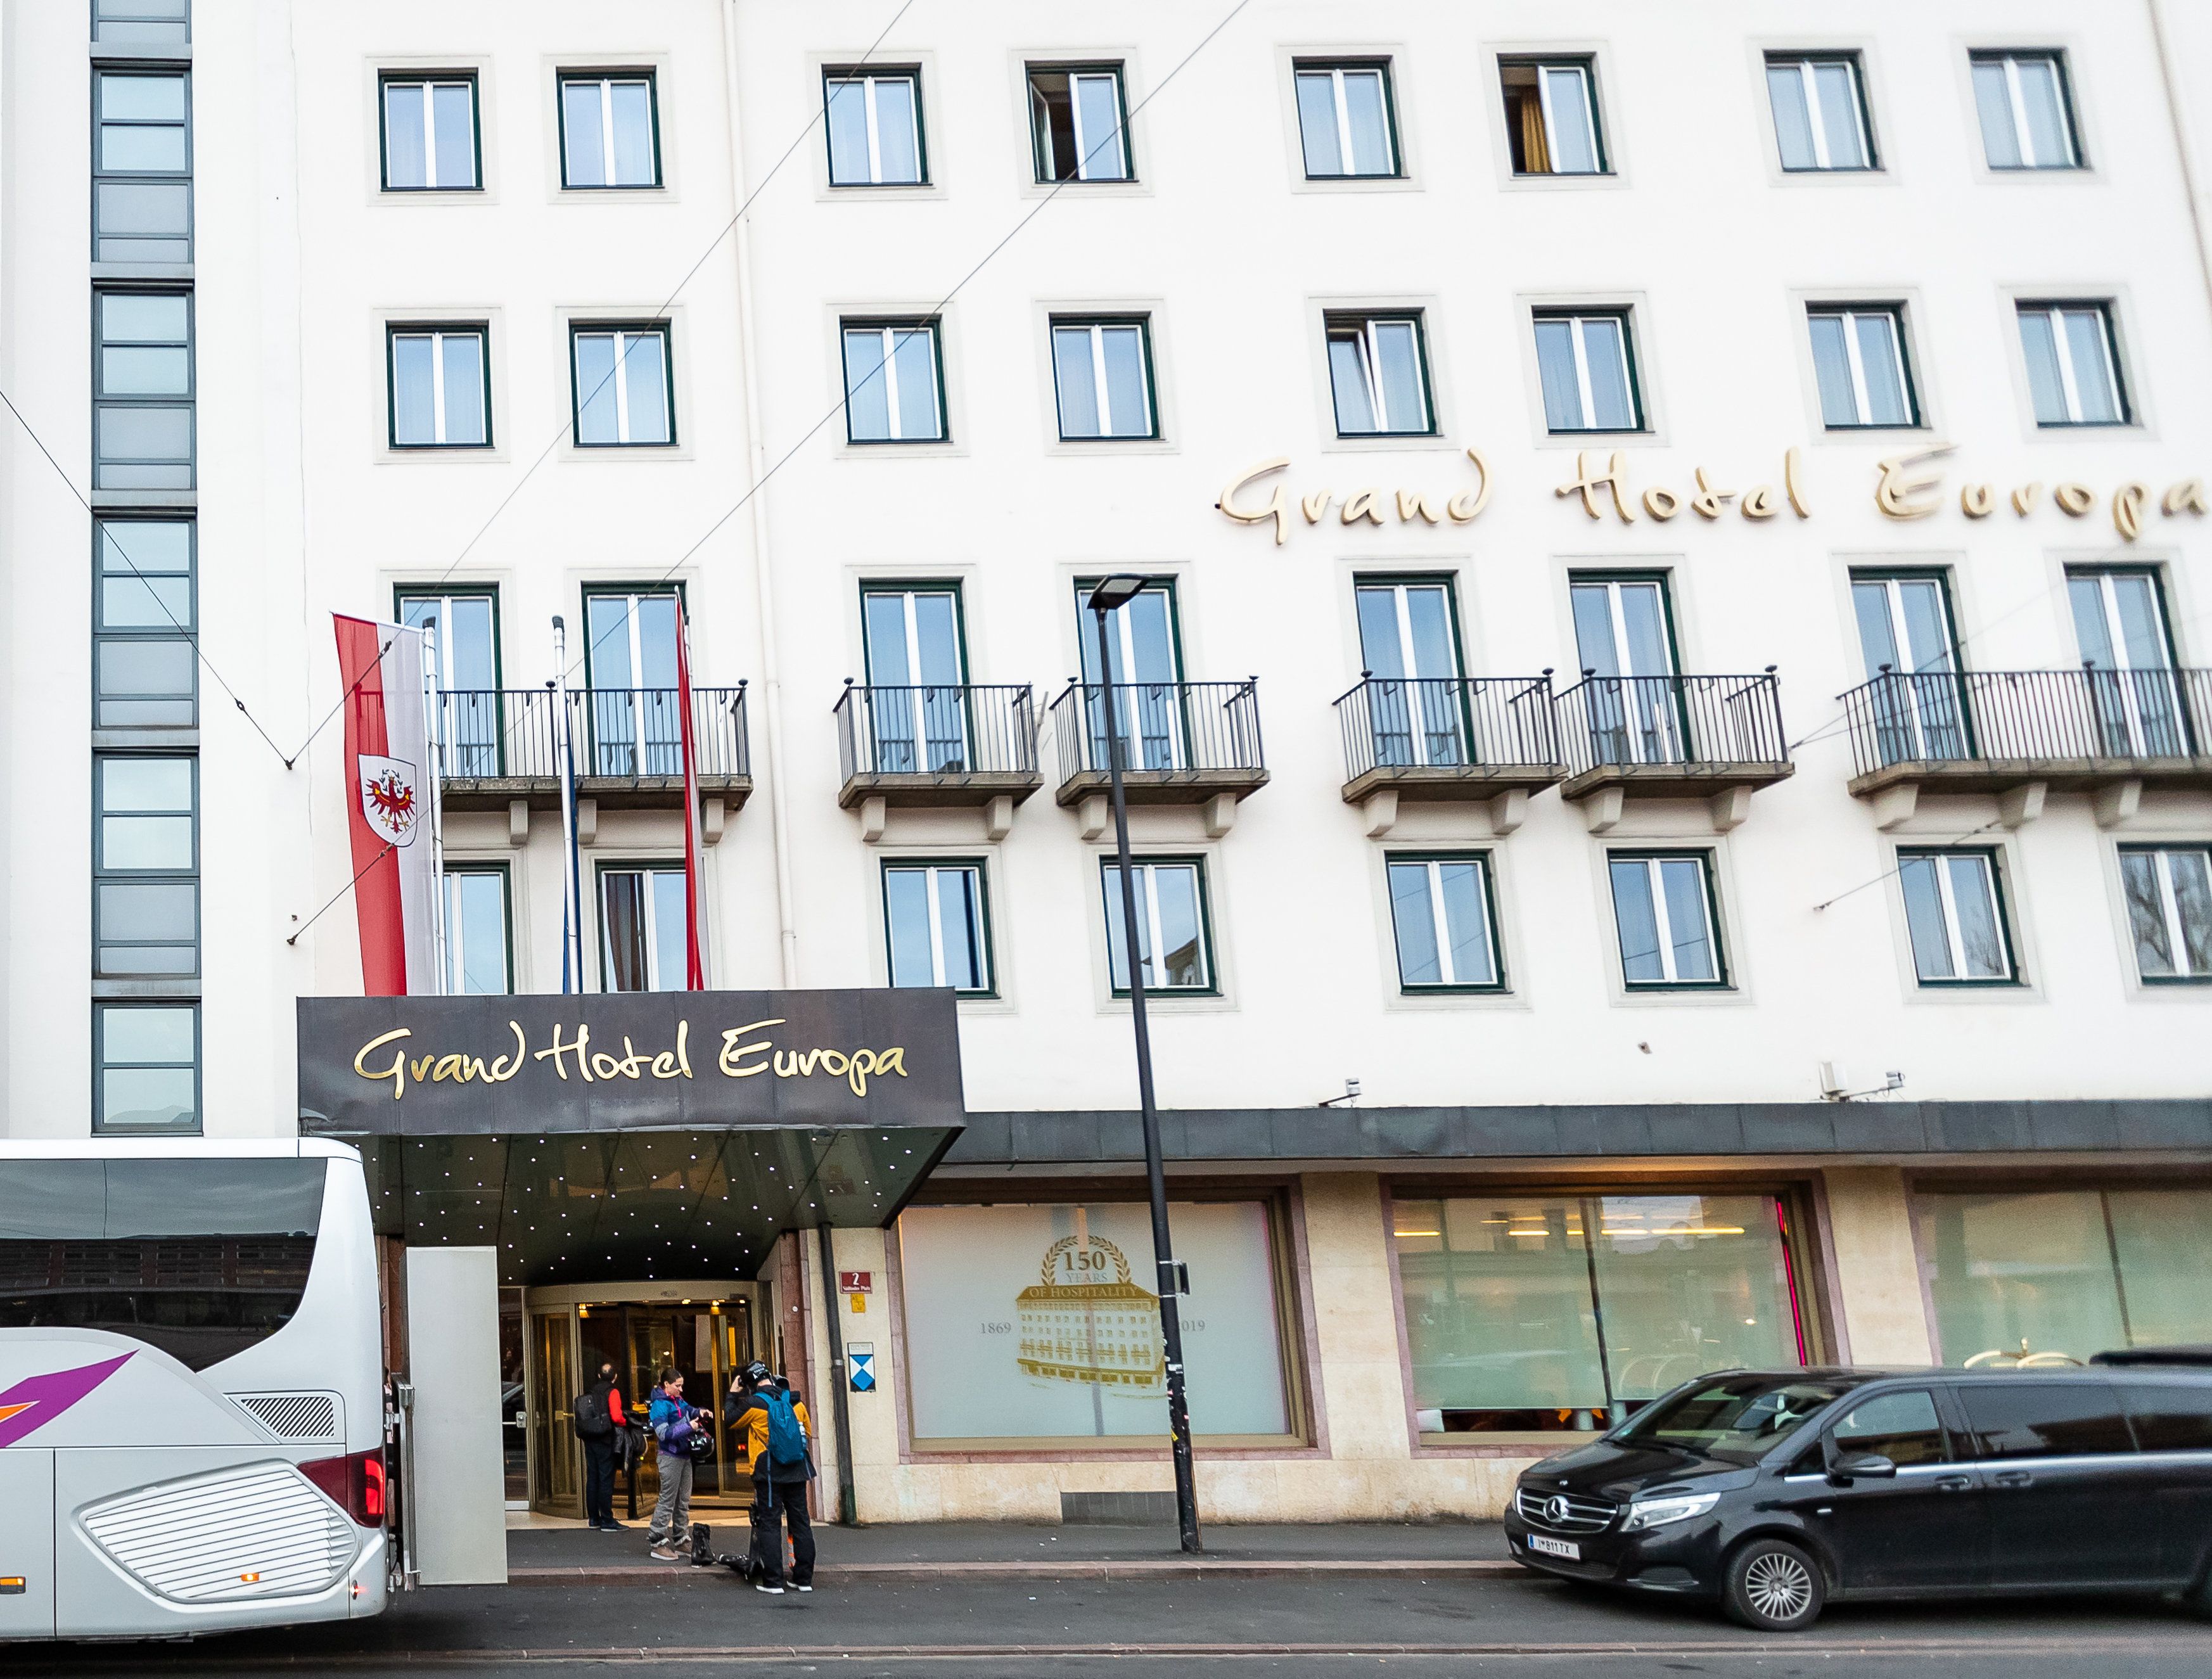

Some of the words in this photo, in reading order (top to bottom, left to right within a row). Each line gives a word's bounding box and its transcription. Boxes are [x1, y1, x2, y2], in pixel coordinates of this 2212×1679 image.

[1218, 449, 1492, 546] Grand
[1556, 449, 1810, 523] Hotel
[1876, 443, 2206, 540] Europa
[353, 1020, 526, 1099] Grand
[534, 1019, 693, 1083] Hotel
[719, 1018, 909, 1097] Europa
[1064, 1251, 1106, 1271] 150
[852, 1272, 859, 1286] 2
[1065, 1272, 1108, 1284] YEARS
[1029, 1287, 1047, 1298] OF
[1051, 1286, 1138, 1298] HOSPITALITY
[980, 1322, 1011, 1334] 1869
[1180, 1320, 1206, 1332] 019
